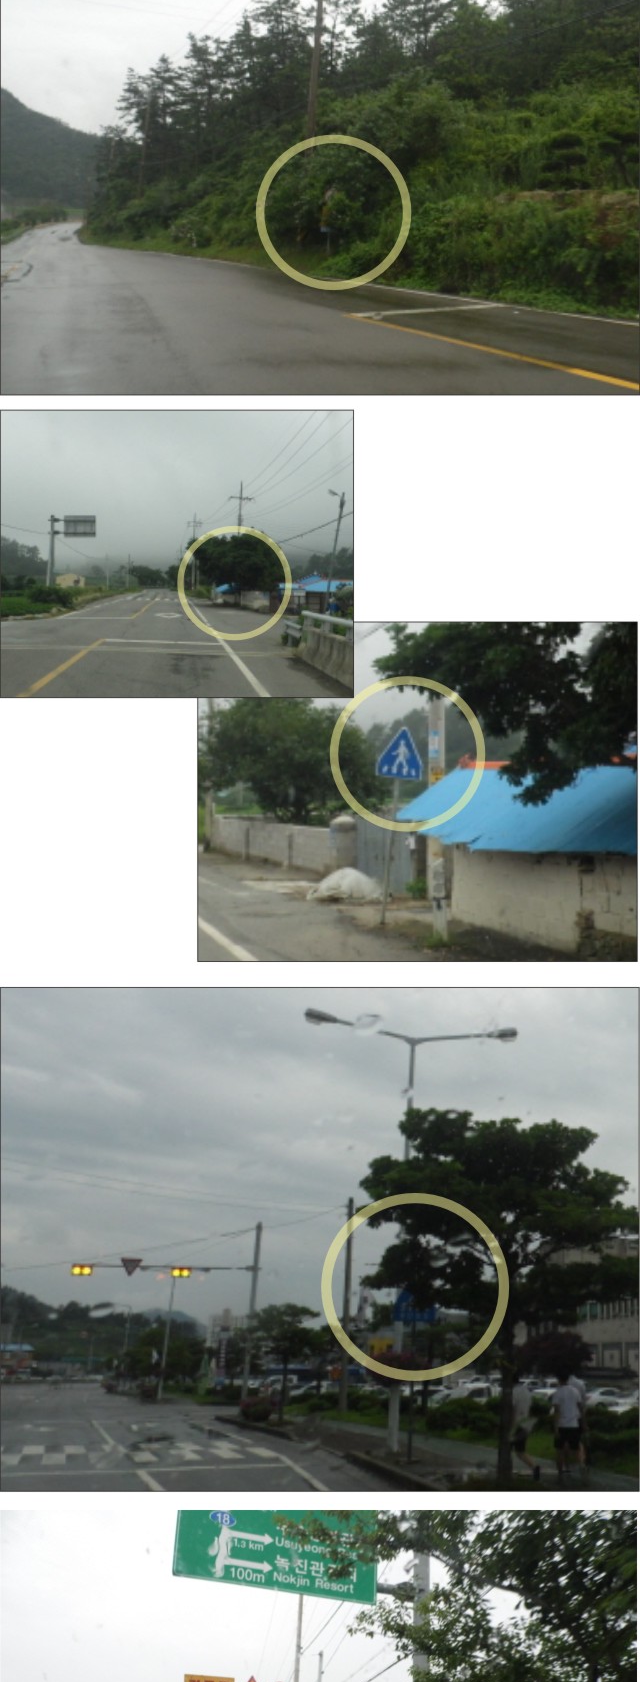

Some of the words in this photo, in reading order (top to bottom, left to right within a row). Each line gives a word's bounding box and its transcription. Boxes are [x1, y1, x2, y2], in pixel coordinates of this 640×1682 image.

[216, 1512, 230, 1525] 18
[233, 1538, 246, 1549] 1.3
[249, 1541, 264, 1552] km
[230, 1567, 266, 1584] 100m
[273, 1572, 310, 1587] Nokjin
[315, 1578, 354, 1594] Resort
